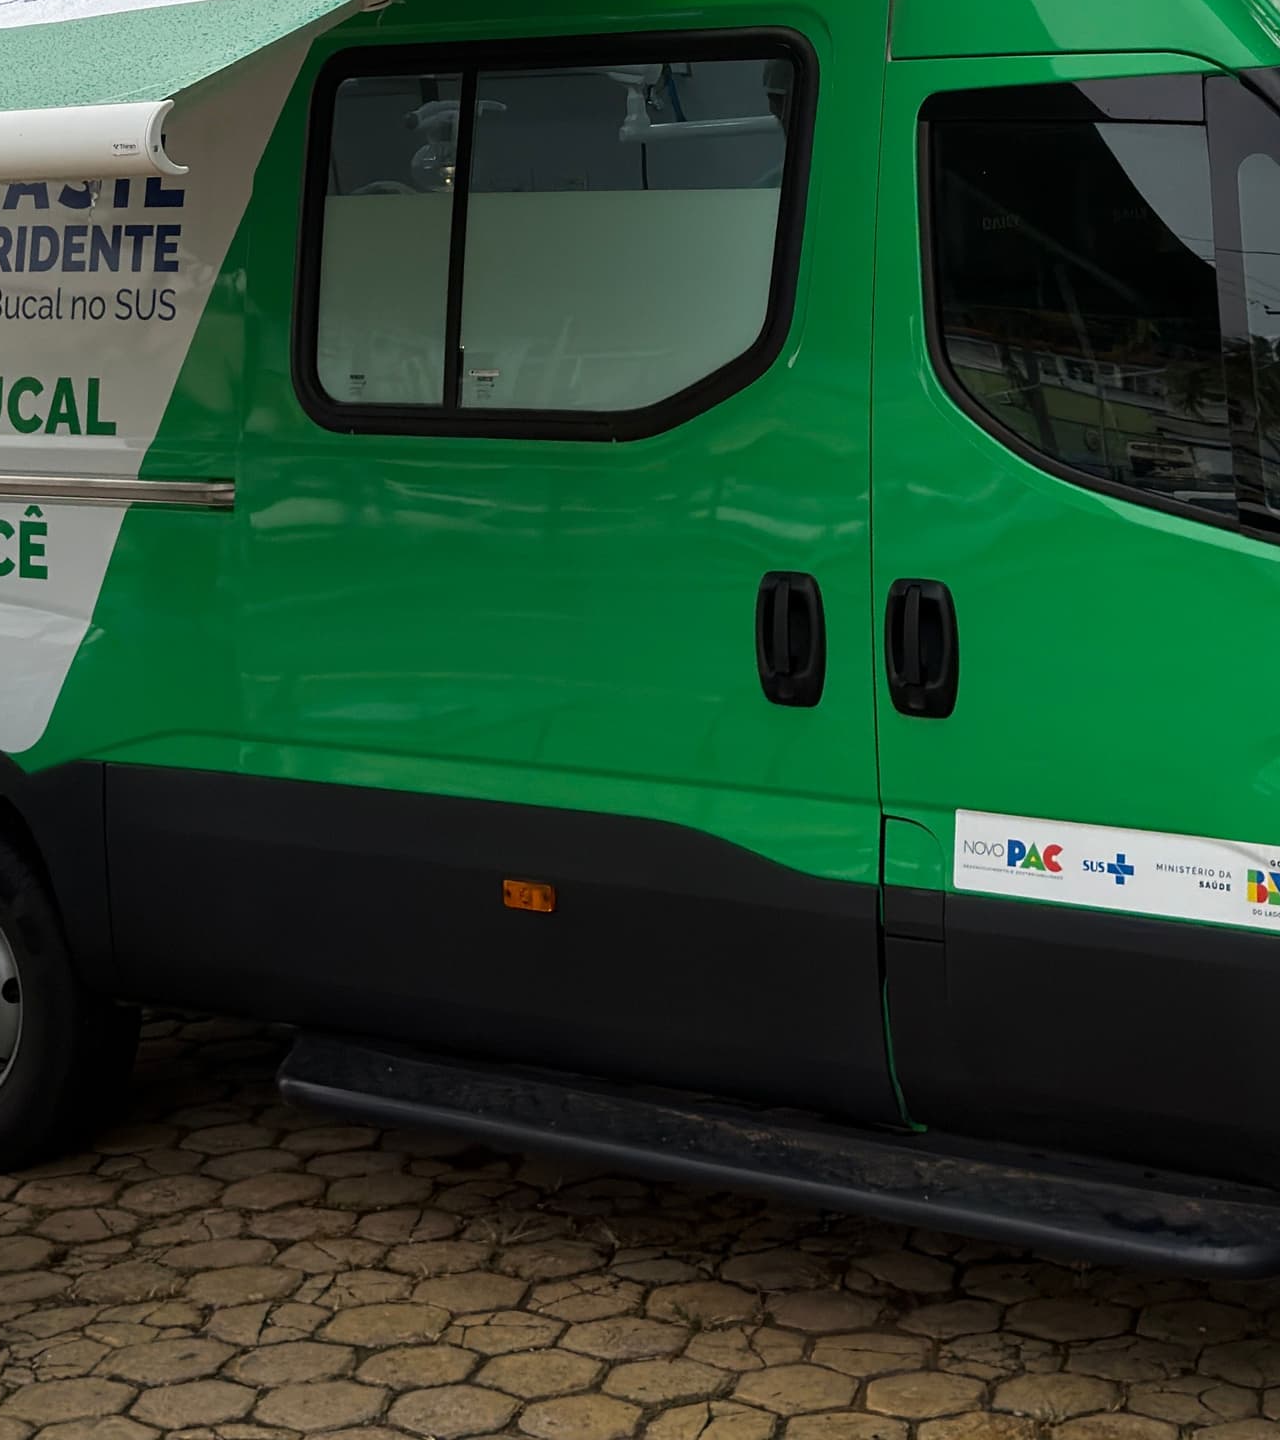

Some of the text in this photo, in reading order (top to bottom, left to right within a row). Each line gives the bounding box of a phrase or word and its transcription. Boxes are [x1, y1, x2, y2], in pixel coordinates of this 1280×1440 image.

[71, 295, 106, 320] no
[115, 288, 177, 321] SUS
[963, 839, 1005, 858] NOVO
[1007, 839, 1064, 873] PAC
[1083, 859, 1105, 873] SUS
[1156, 862, 1232, 879] MINISTÉRIO DA
[1199, 879, 1232, 892] SAÚDE
